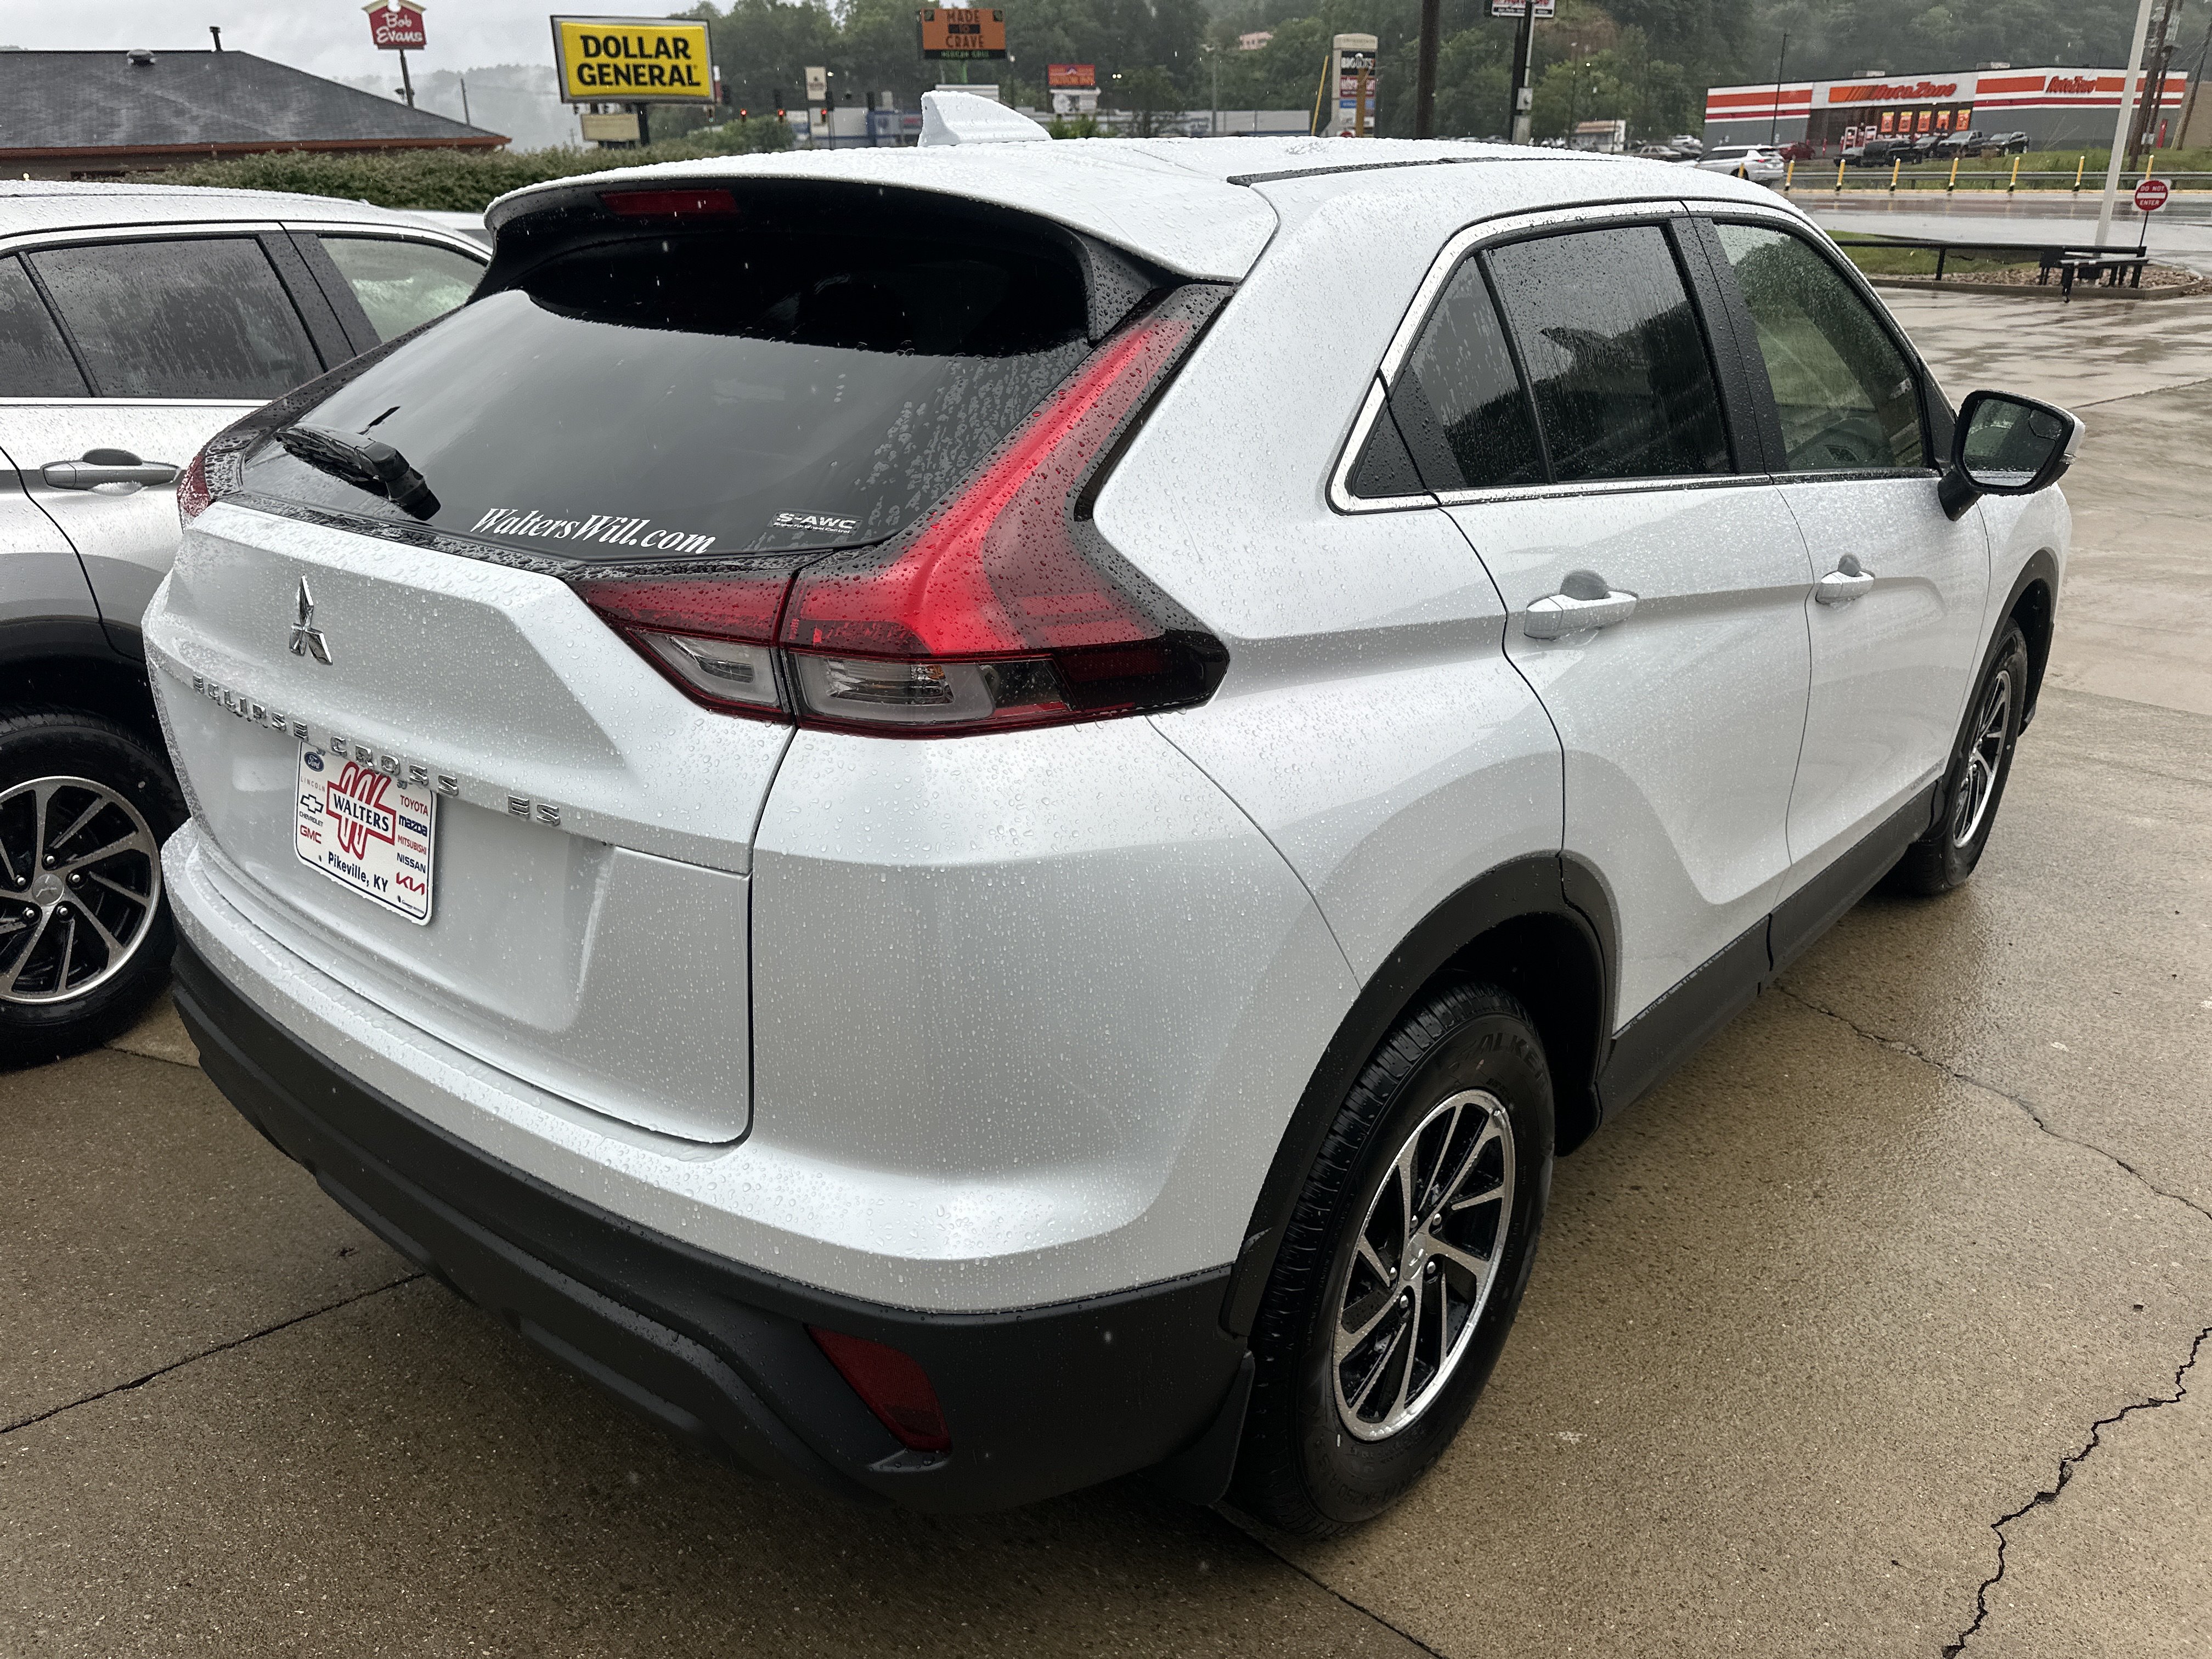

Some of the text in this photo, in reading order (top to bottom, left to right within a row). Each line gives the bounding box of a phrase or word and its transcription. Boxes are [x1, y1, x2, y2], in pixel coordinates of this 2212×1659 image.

[381, 12, 412, 28] Bob
[946, 9, 980, 23] MADE
[376, 26, 423, 43] Evans
[945, 35, 984, 48] CRAVE
[580, 34, 692, 60] DOLLAR
[577, 63, 701, 86] GENERAL
[1870, 81, 1957, 100] AutoZone
[470, 508, 716, 554] WaltersWill.com
[777, 513, 856, 529] S-AWC
[192, 674, 561, 826] ECLIPSE CROSS ES
[300, 776, 325, 792] LINCOLN
[333, 793, 390, 832] WALTERS
[400, 794, 428, 816] TOYOTA
[299, 811, 324, 827] CHEVROLET
[398, 815, 428, 837] mazda
[300, 825, 322, 844] GMC
[397, 834, 427, 855] MITSUBISHI
[328, 851, 388, 893] Pikeville, KY
[397, 852, 426, 874] NISSAN
[396, 872, 425, 896] KIA
